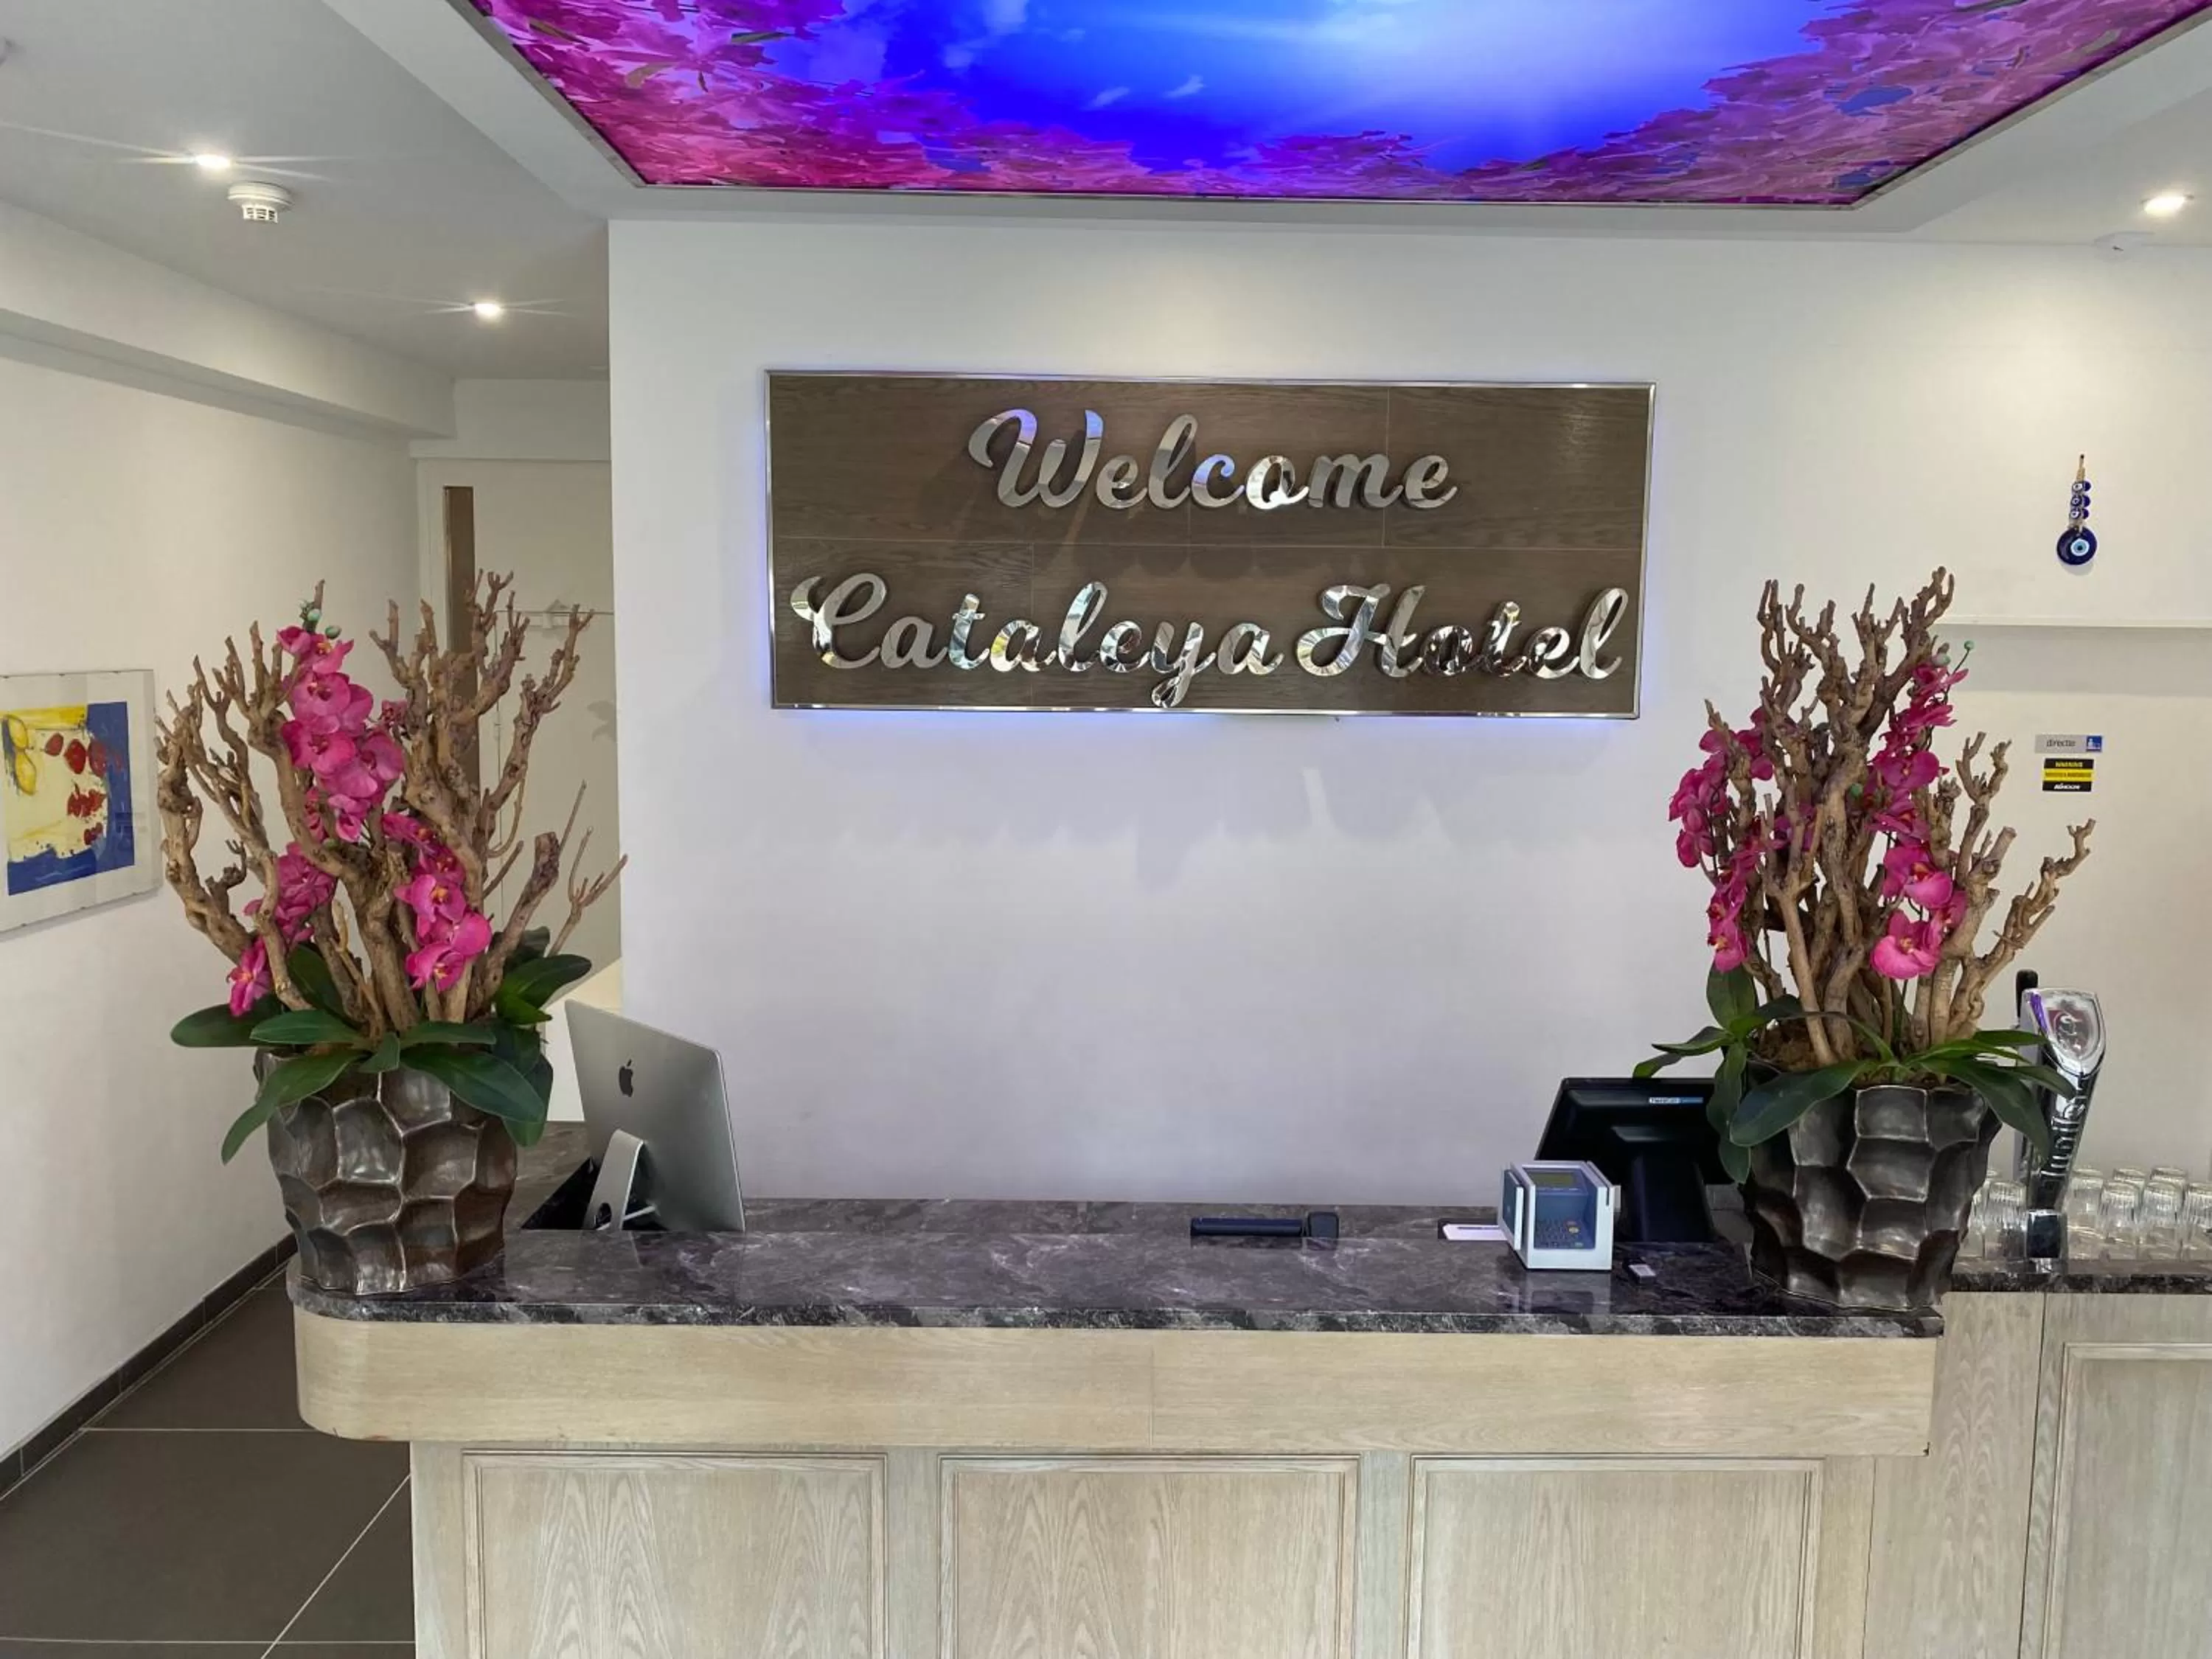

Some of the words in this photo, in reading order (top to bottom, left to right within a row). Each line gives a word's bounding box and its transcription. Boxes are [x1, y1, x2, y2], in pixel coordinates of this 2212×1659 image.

[967, 408, 1458, 510] Welcome
[790, 572, 1285, 709] Cataleya
[1295, 582, 1629, 679] Hotel
